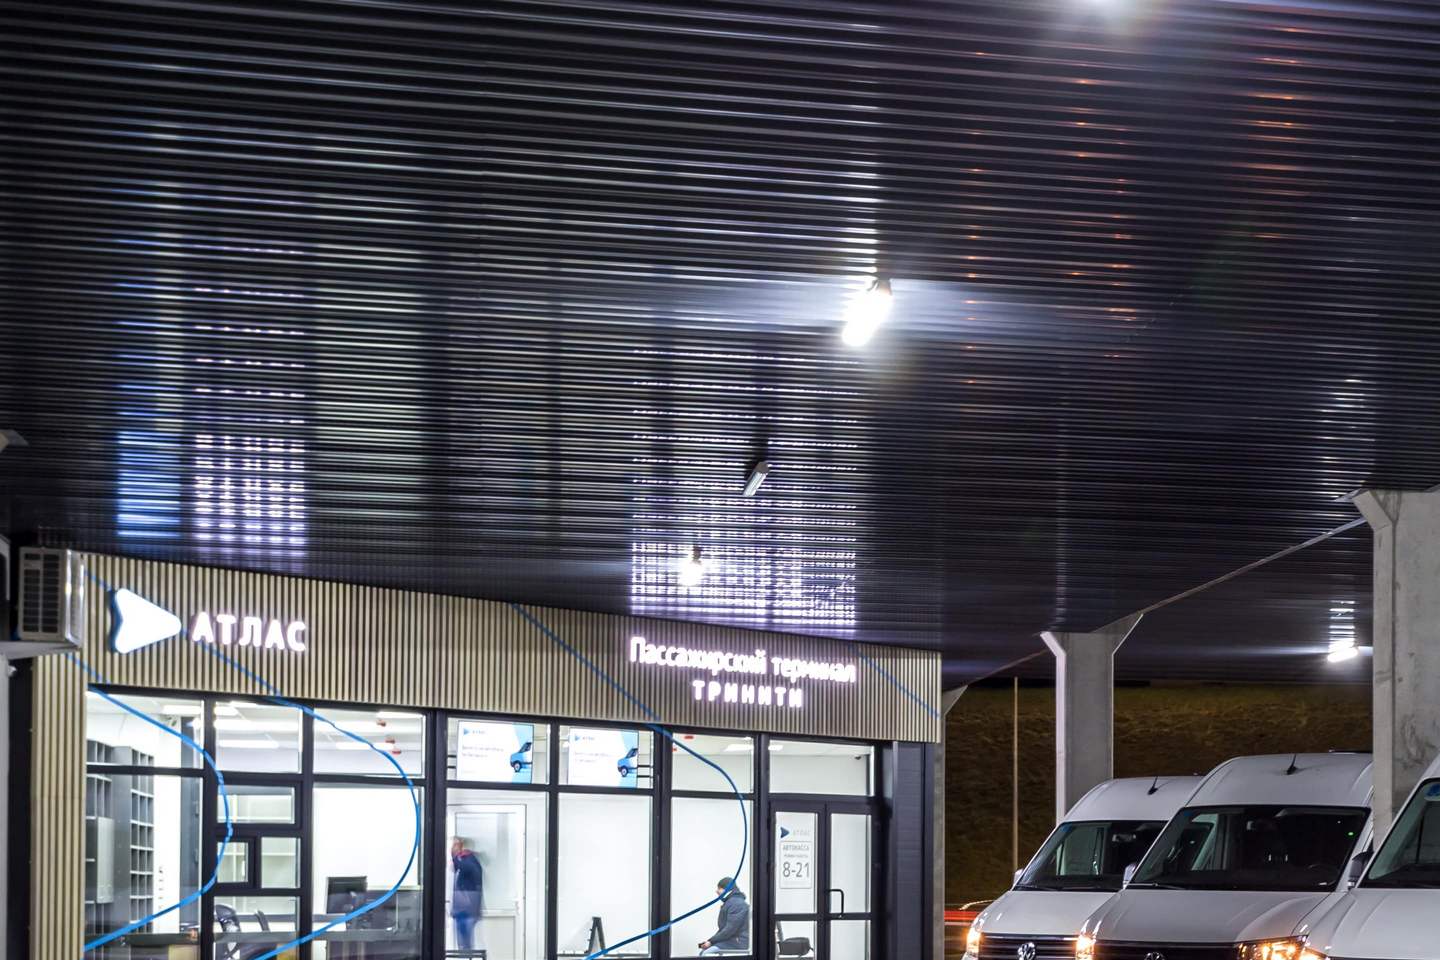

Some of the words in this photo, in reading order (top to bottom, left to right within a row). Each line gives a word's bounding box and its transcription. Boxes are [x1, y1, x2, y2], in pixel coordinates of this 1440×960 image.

[191, 611, 306, 651] АТЛАС
[630, 636, 767, 676] Пассажирский
[771, 656, 856, 683] терминал
[692, 680, 803, 708] ТРИНИТИ
[782, 861, 810, 878] 8-21
